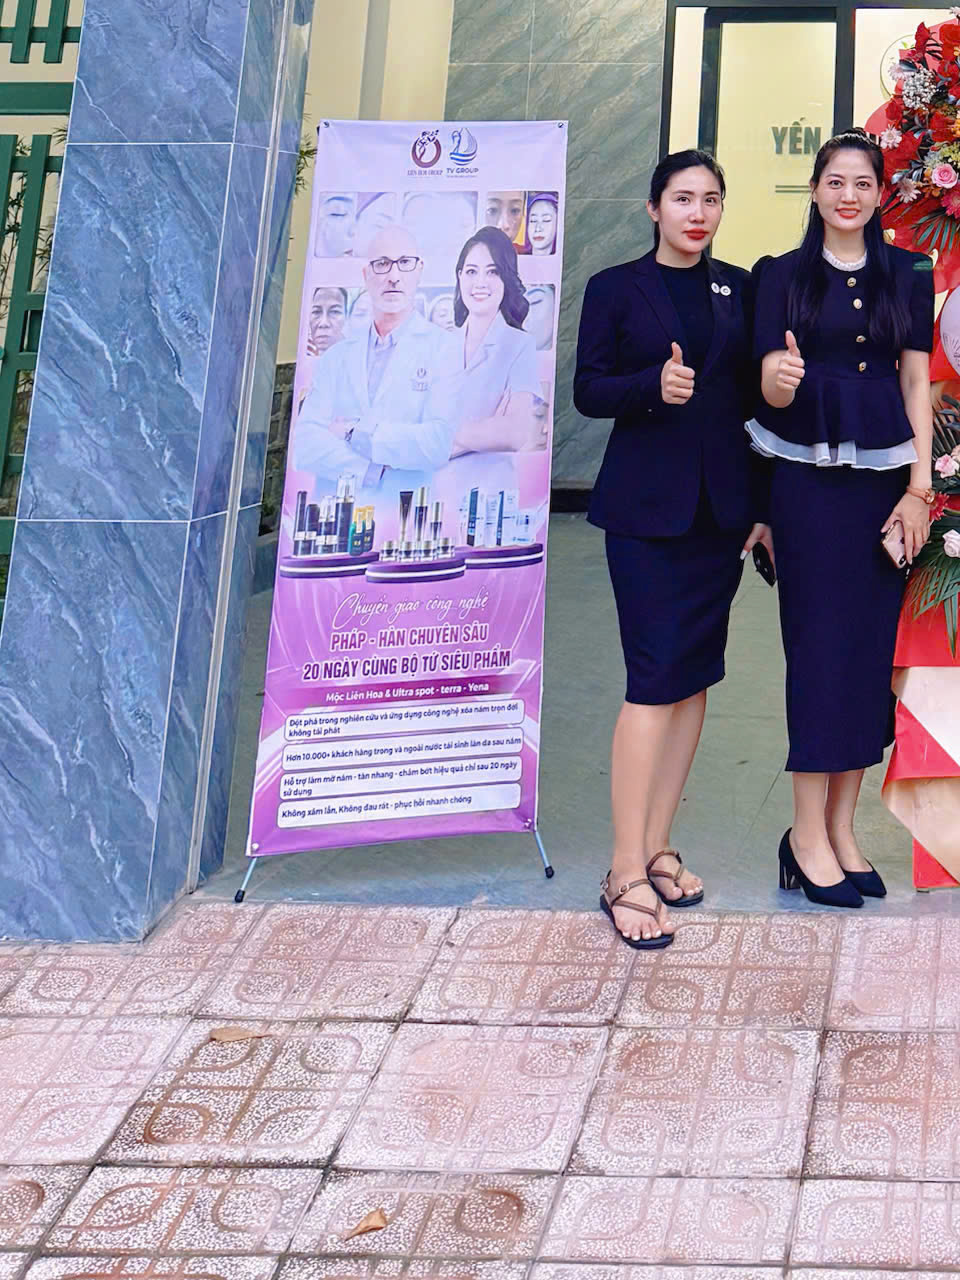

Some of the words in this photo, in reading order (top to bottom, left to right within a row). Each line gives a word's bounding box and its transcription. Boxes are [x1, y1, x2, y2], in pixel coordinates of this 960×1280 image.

[771, 117, 821, 155] YẾN
[388, 599, 419, 624] giao
[426, 596, 453, 621] công
[332, 629, 366, 651] PHÁP
[378, 626, 405, 647] HÀN
[409, 623, 459, 645] CHUYÊN
[463, 621, 488, 642] SÂU
[303, 663, 319, 680] 20
[323, 657, 358, 679] NGÀY
[362, 654, 397, 676] CÙNG
[401, 652, 418, 677] BỘ
[441, 650, 469, 670] SIÊU
[474, 644, 511, 669] PHẨM
[326, 692, 344, 703] Mộc
[346, 691, 364, 701] Liên
[366, 690, 383, 699] Hoa
[384, 690, 391, 698] &
[392, 688, 413, 698] Ultra
[415, 687, 434, 698] spot
[441, 685, 461, 694] terra
[468, 683, 489, 693] Yena
[319, 717, 338, 725] trong
